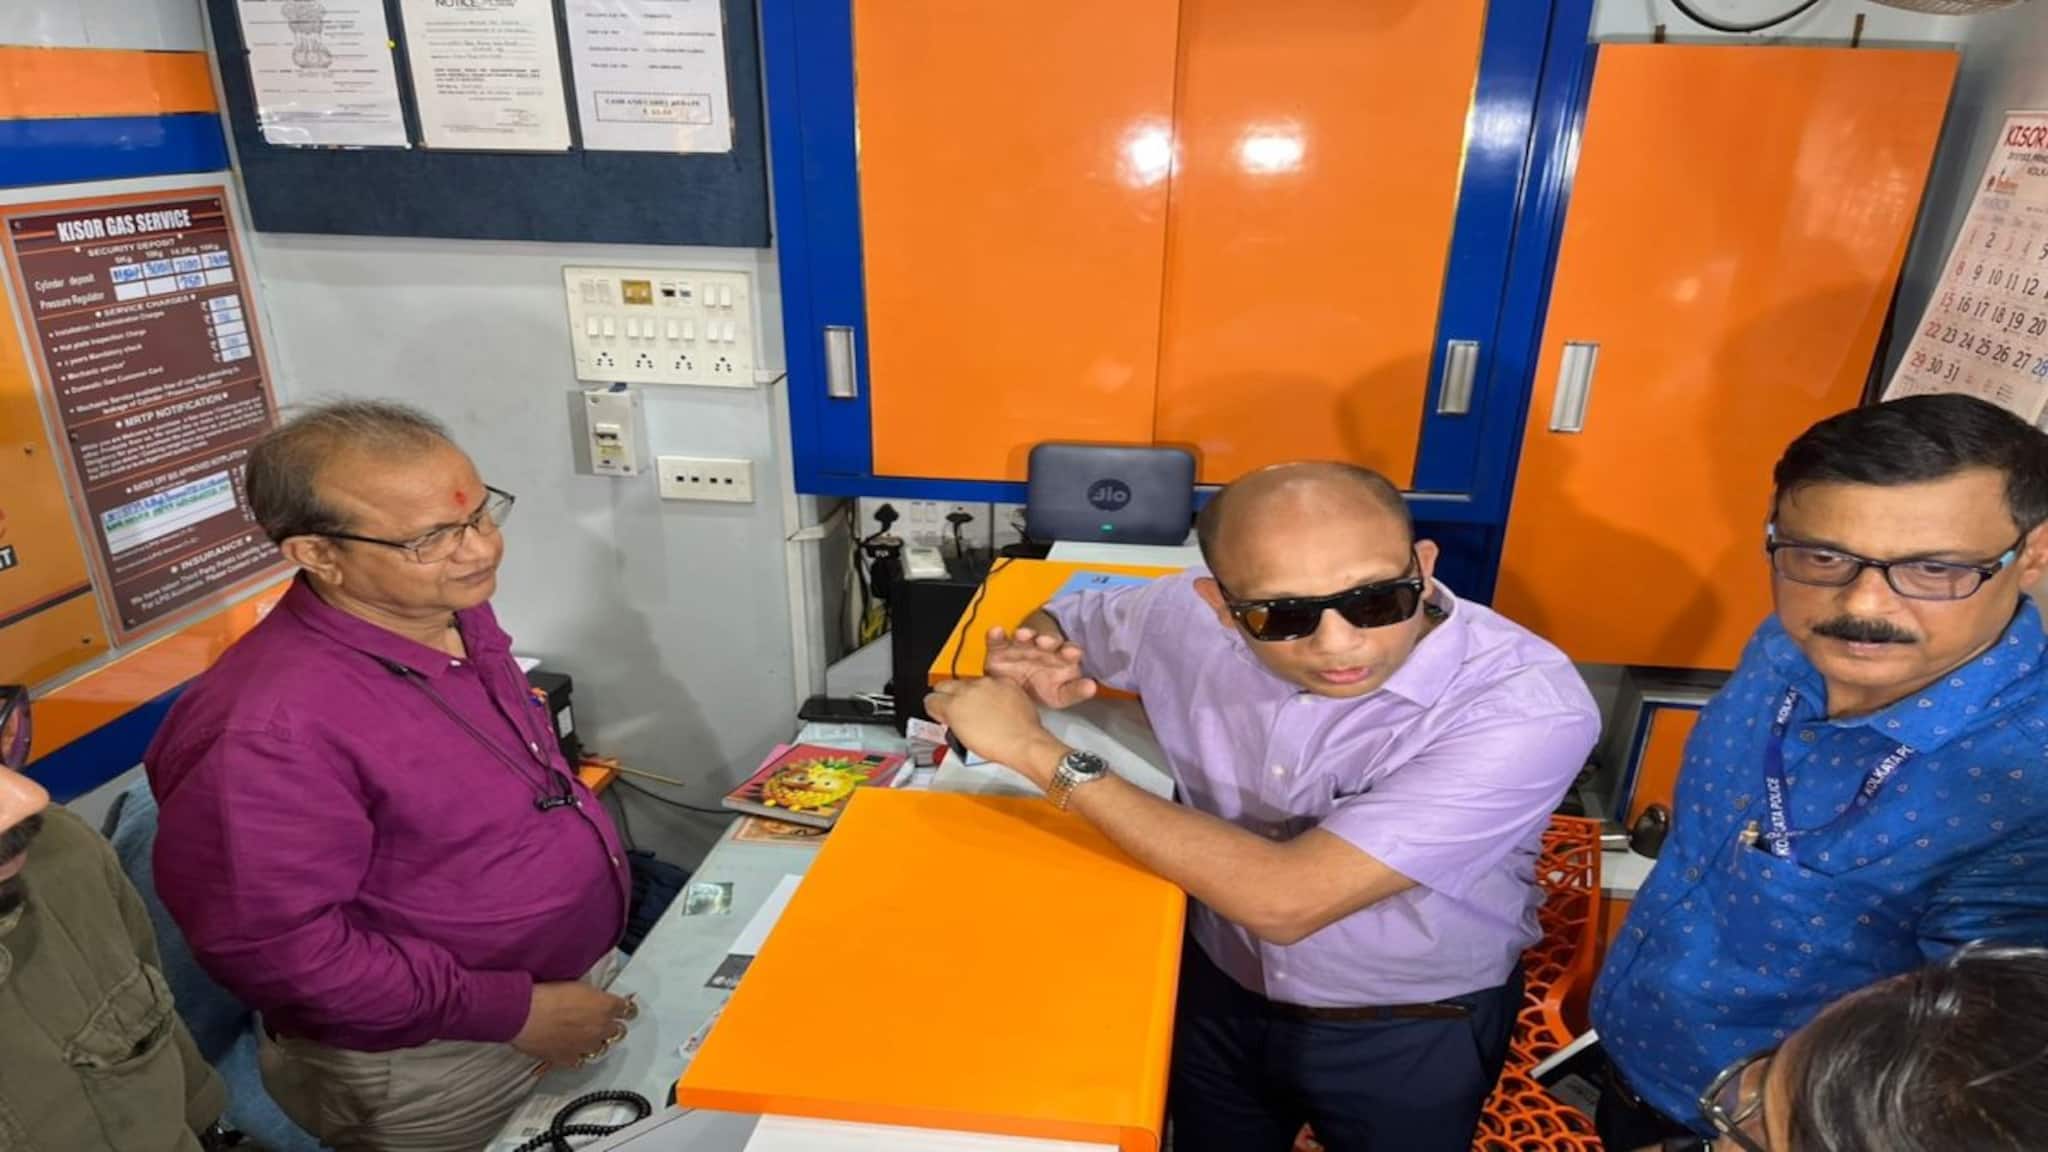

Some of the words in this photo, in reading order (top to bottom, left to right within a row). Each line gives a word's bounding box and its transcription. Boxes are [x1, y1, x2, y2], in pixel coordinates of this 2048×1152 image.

[57, 218, 104, 242] KISOR
[106, 214, 136, 236] GAS
[136, 209, 193, 232] SERVICE
[1985, 231, 1996, 248] 2
[88, 243, 135, 256] SECURITY
[138, 238, 175, 250] DEPOSIT
[1972, 264, 1983, 280] 9
[1987, 268, 2003, 286] 10
[2004, 272, 2020, 291] 11
[2022, 277, 2040, 296] 12
[104, 303, 143, 316] SERVICE
[146, 295, 189, 309] CHARGES
[1957, 296, 1972, 313] 16
[1974, 301, 1990, 318] 17
[1991, 305, 2006, 324] 18
[2007, 311, 2025, 330] 19
[2027, 316, 2047, 336] 20
[1925, 321, 1942, 339] 22
[1941, 327, 1958, 344] 23
[1958, 332, 1975, 350] 24
[1975, 338, 1992, 356] 25
[1992, 344, 2011, 363] 26
[2012, 350, 2032, 369] 27
[2032, 357, 2048, 377] 28
[1926, 356, 1943, 374] 30
[1943, 363, 1960, 382] 31
[1091, 485, 1128, 503] Jio
[181, 538, 244, 570] INSURANCE
[1765, 776, 1783, 810] POLICE
